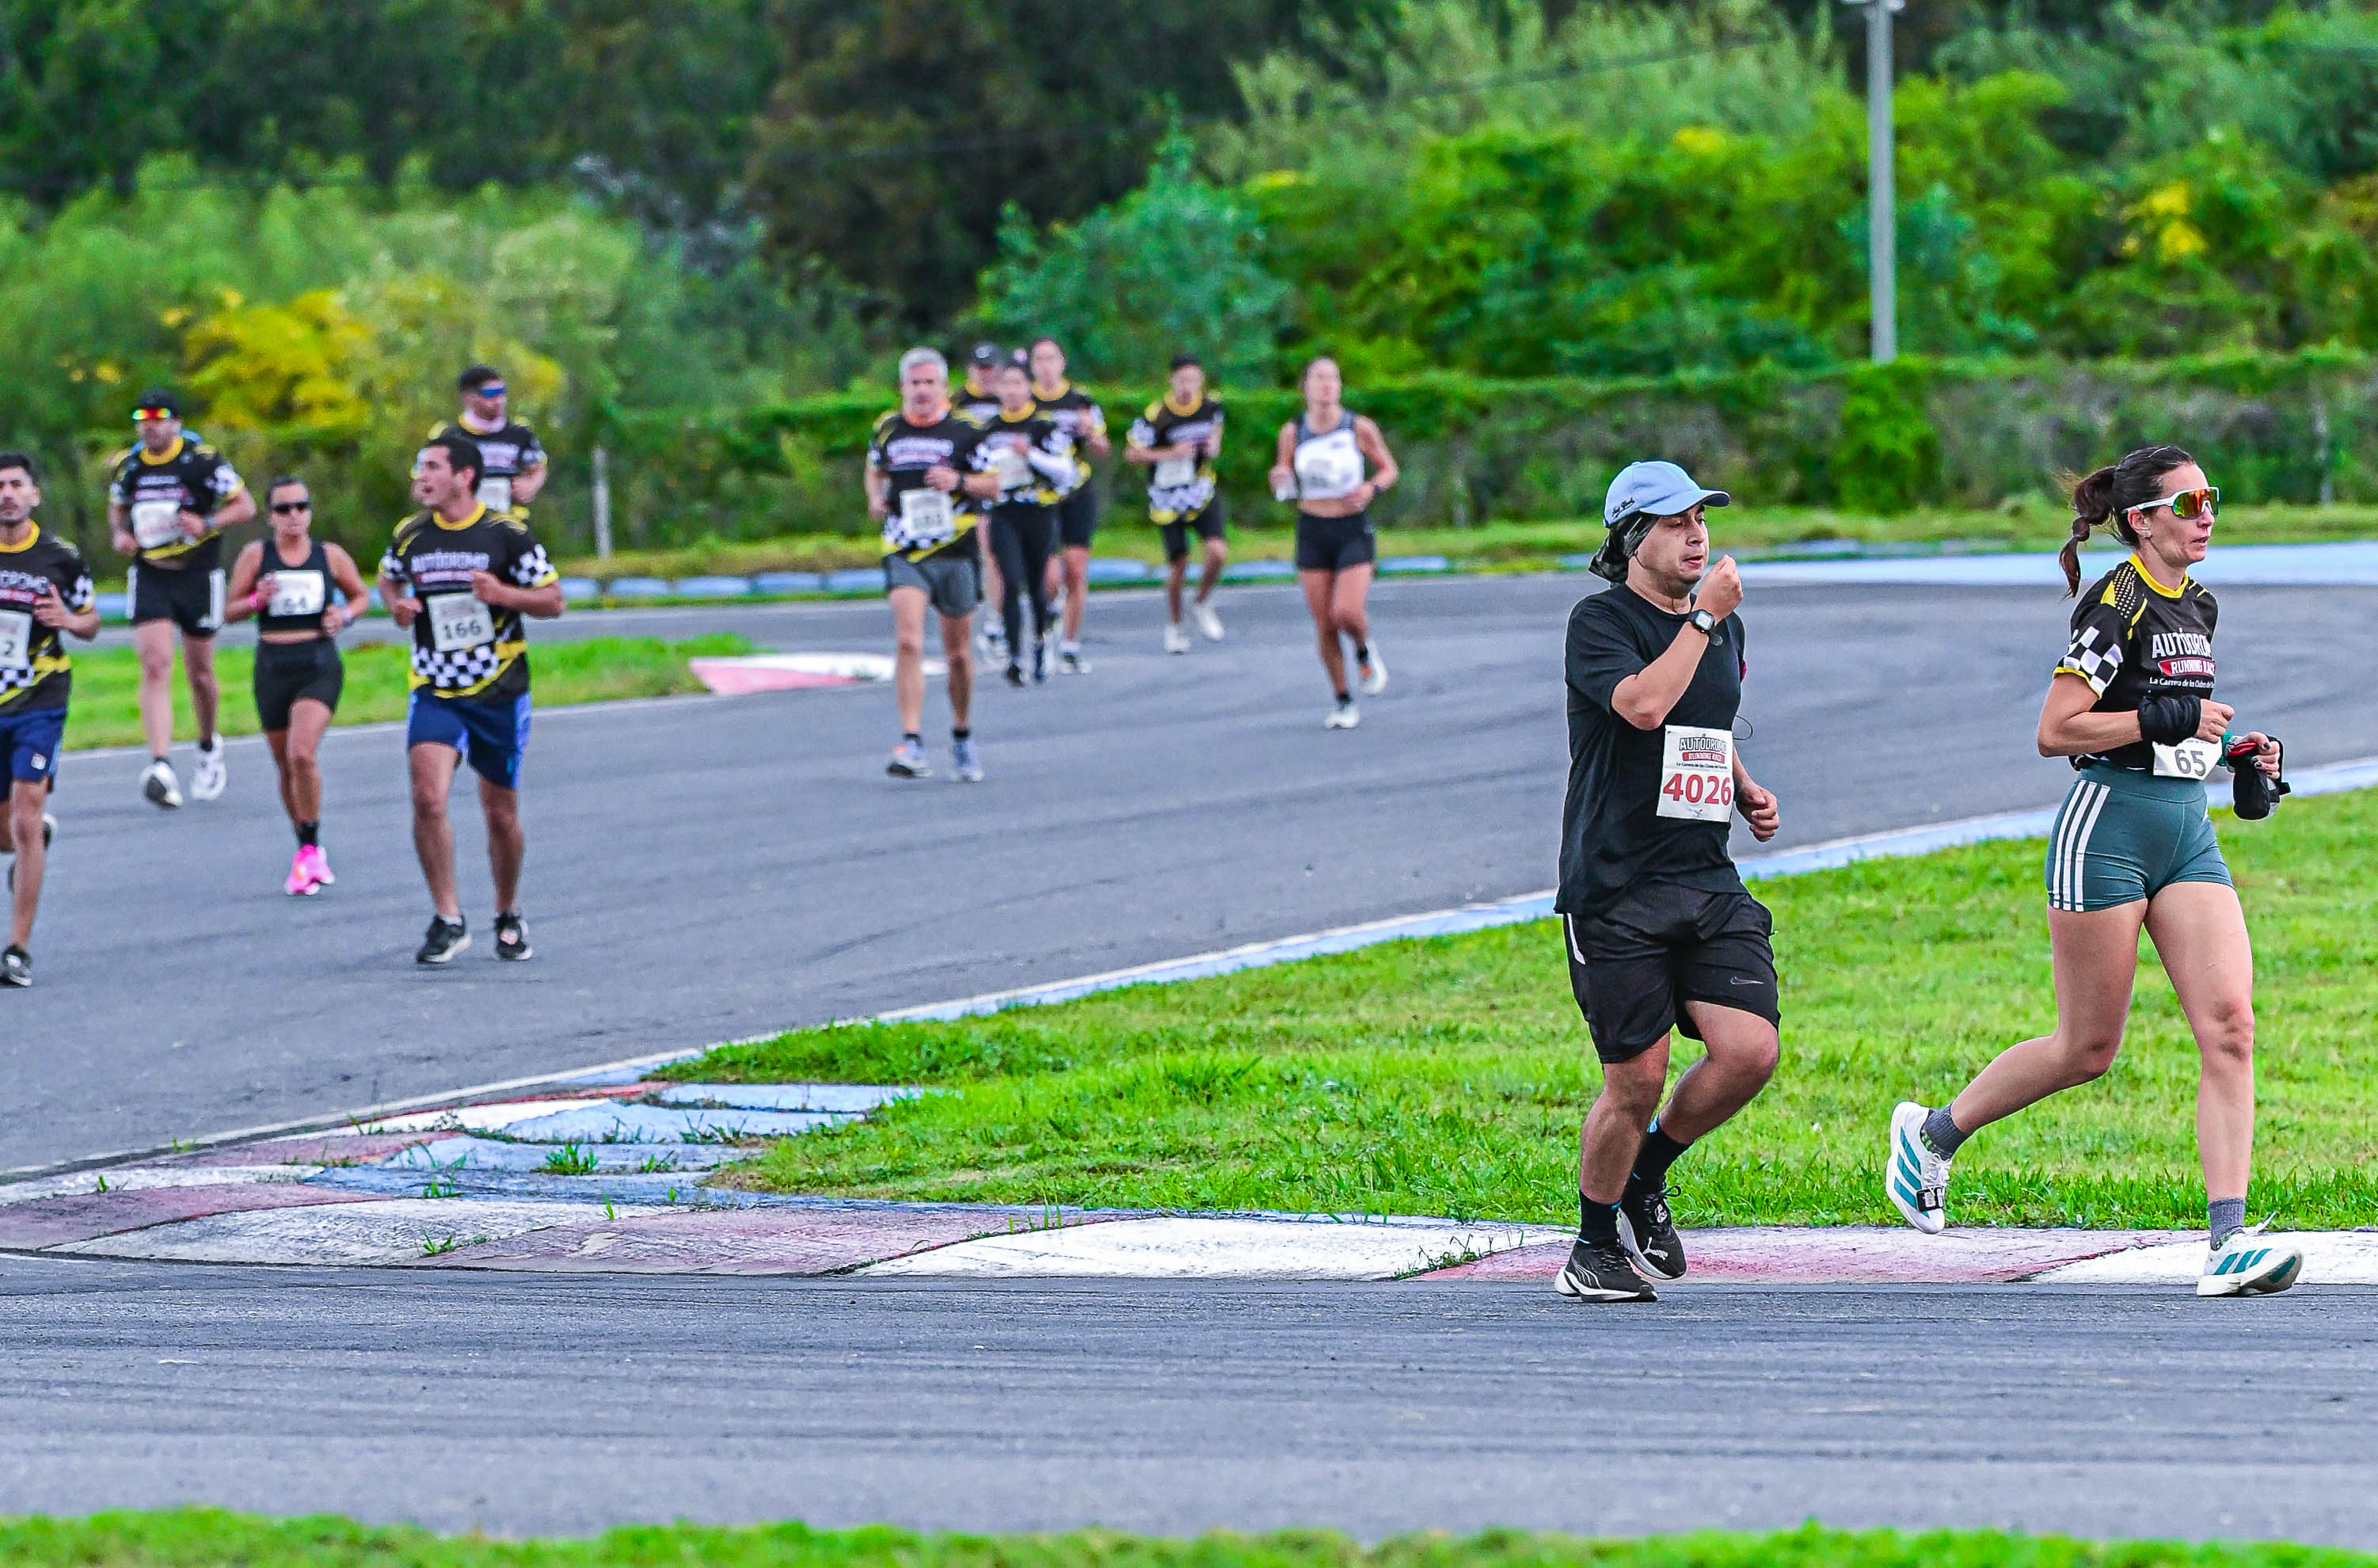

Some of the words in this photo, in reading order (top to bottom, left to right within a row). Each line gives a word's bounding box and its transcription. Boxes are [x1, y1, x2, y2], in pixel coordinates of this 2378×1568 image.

[444, 620, 482, 640] 166
[2152, 627, 2212, 659] AUTÓDROM
[2174, 749, 2206, 777] 65
[1662, 773, 1732, 805] 4026
